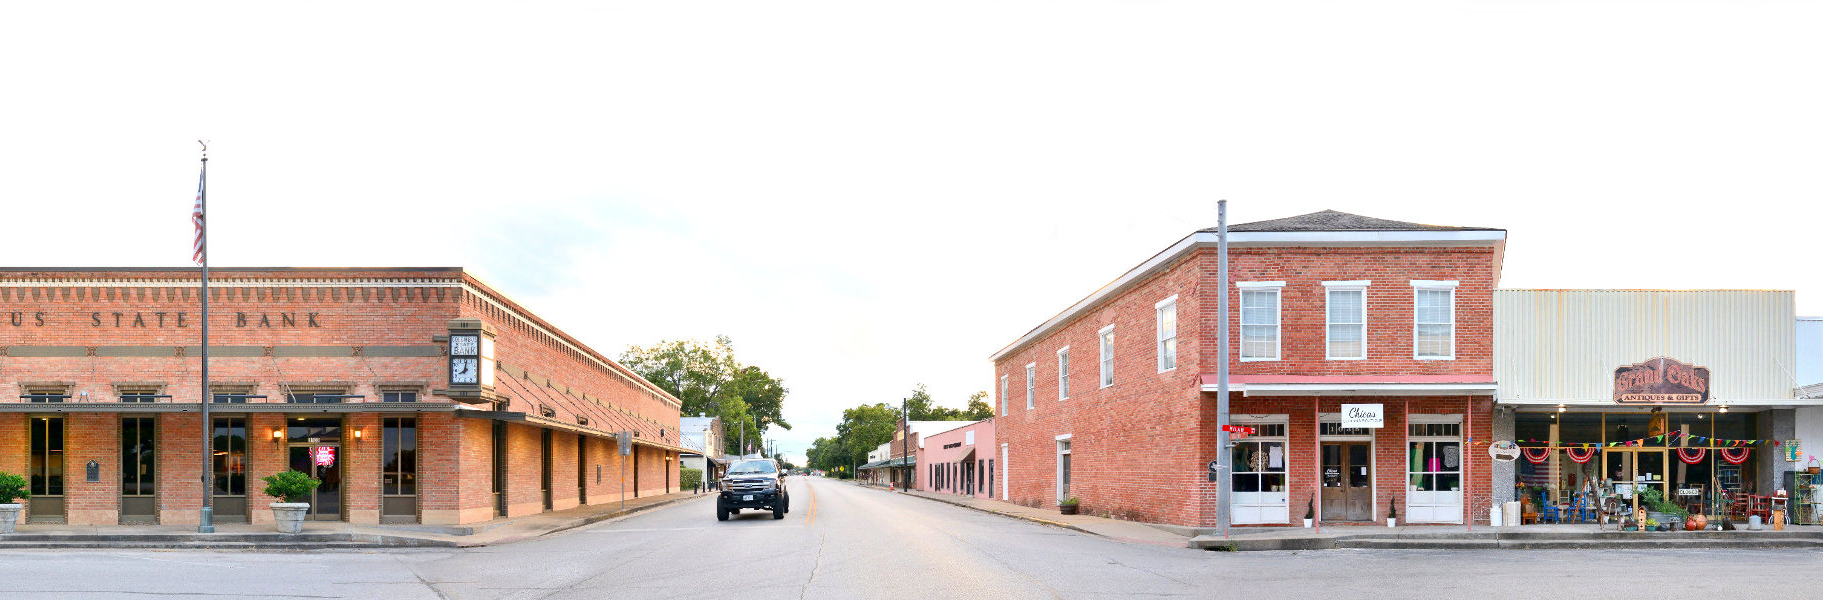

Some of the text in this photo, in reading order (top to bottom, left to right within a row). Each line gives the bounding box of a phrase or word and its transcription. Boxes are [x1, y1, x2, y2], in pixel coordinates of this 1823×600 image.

[91, 312, 188, 328] STATE
[235, 312, 323, 328] BANK
[454, 347, 476, 355] BANK
[1618, 364, 1706, 393] Grand Oaks
[1349, 407, 1376, 419] Chicas
